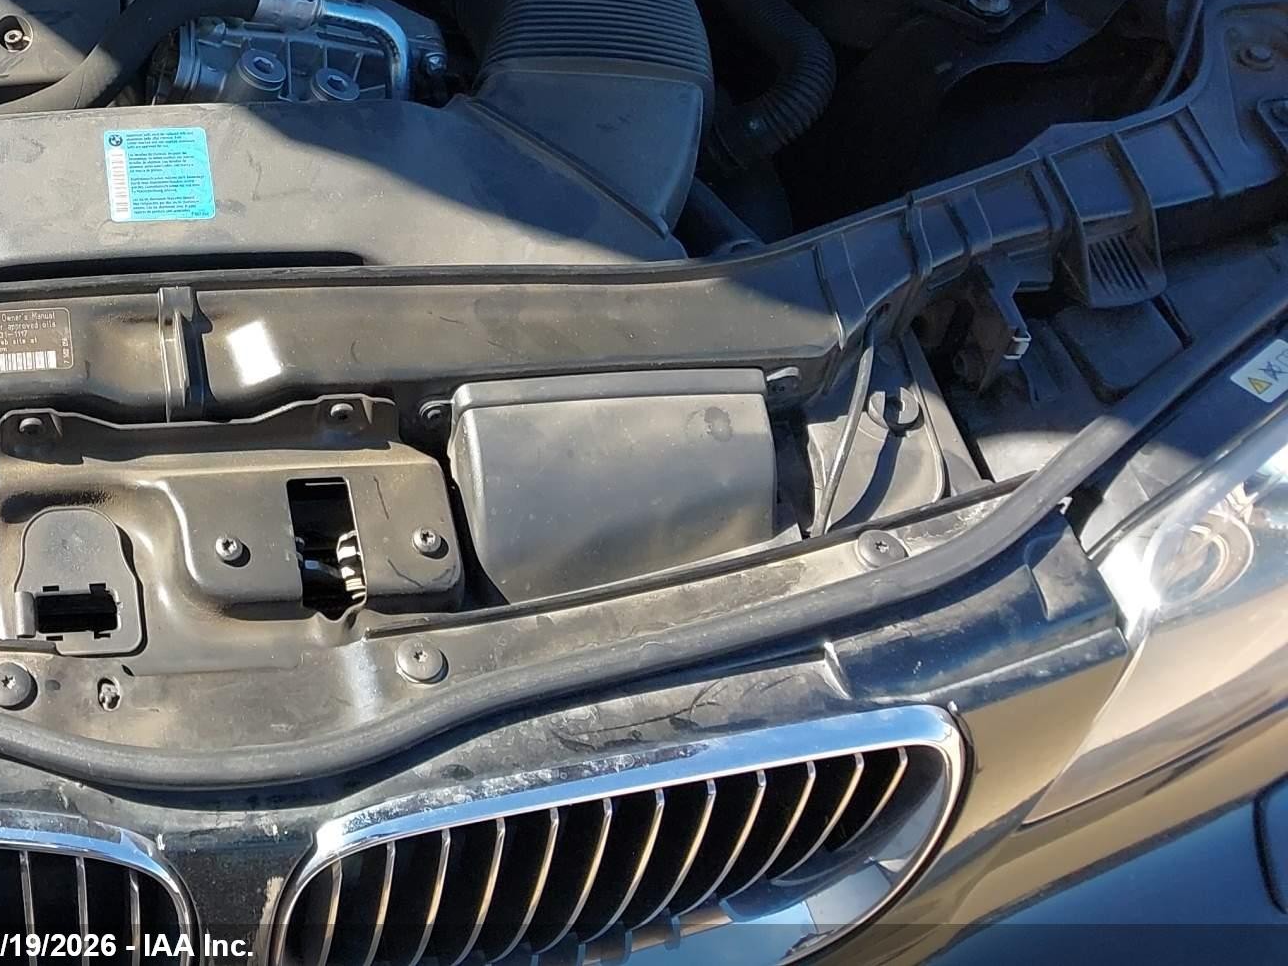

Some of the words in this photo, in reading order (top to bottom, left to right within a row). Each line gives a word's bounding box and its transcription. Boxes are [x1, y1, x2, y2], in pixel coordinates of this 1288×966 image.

[31, 311, 55, 320] Manual
[7, 321, 39, 331] approved
[41, 320, 56, 328] oils
